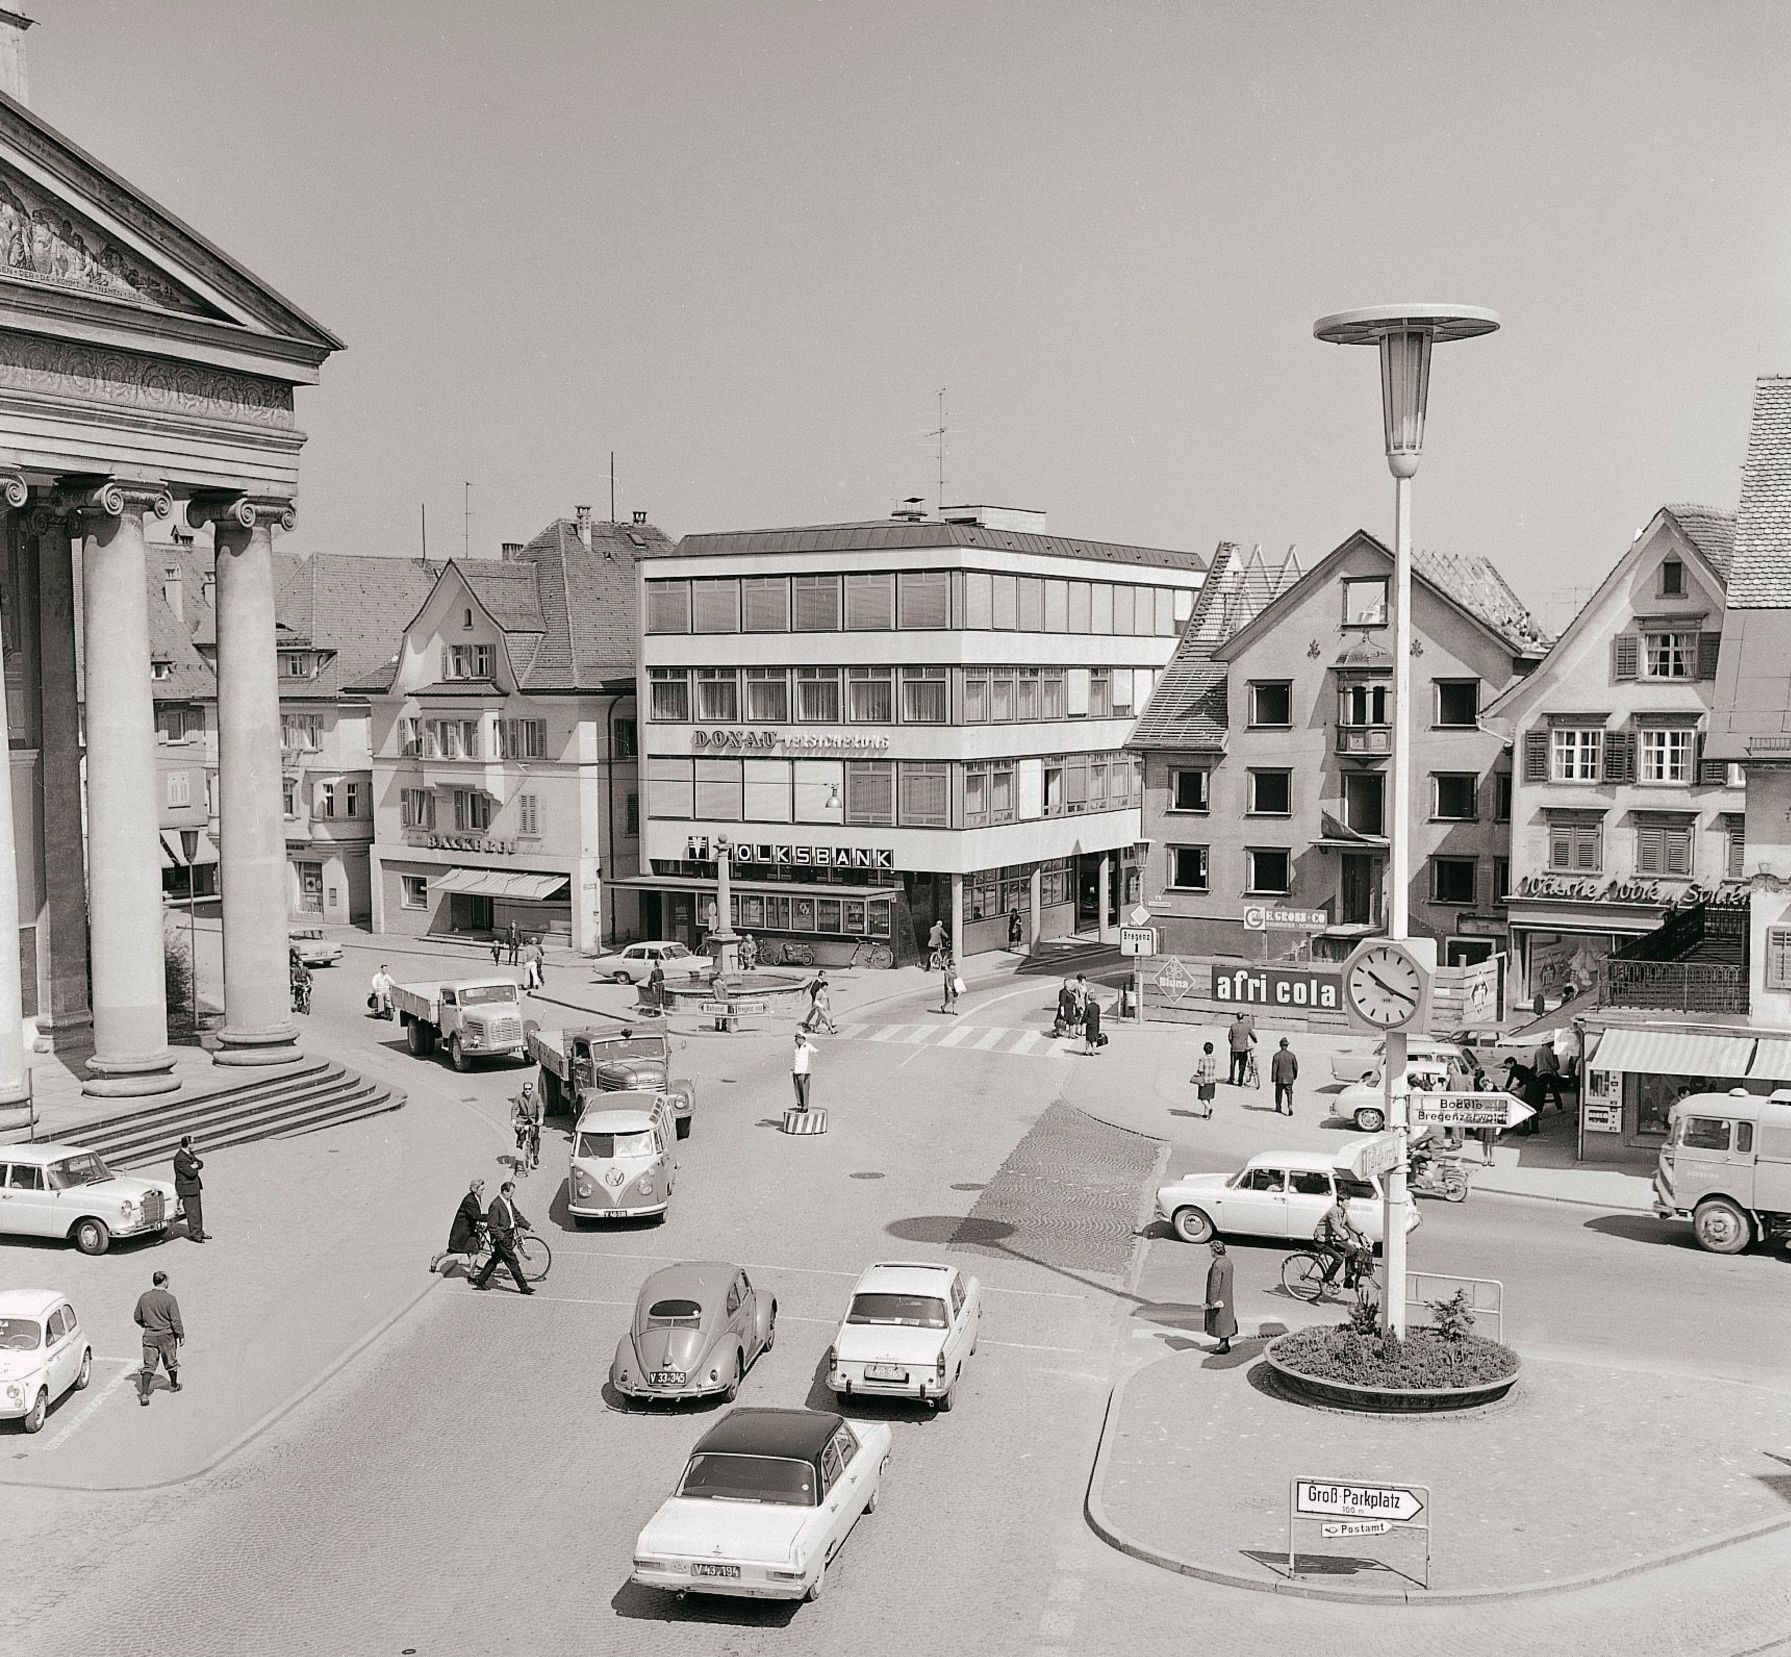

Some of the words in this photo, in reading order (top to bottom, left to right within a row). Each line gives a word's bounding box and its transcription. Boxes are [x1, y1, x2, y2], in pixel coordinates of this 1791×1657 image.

[693, 730, 778, 749] DONAU
[718, 841, 890, 867] OLKSBANK
[1122, 931, 1151, 942] Bregenz
[1159, 976, 1189, 989] Bluna
[1217, 969, 1267, 1003] afri
[1276, 979, 1337, 1008] cola
[1343, 1488, 1400, 1510] Parkplatz
[1342, 1505, 1356, 1514] 100
[1341, 1522, 1385, 1534] Postamt
